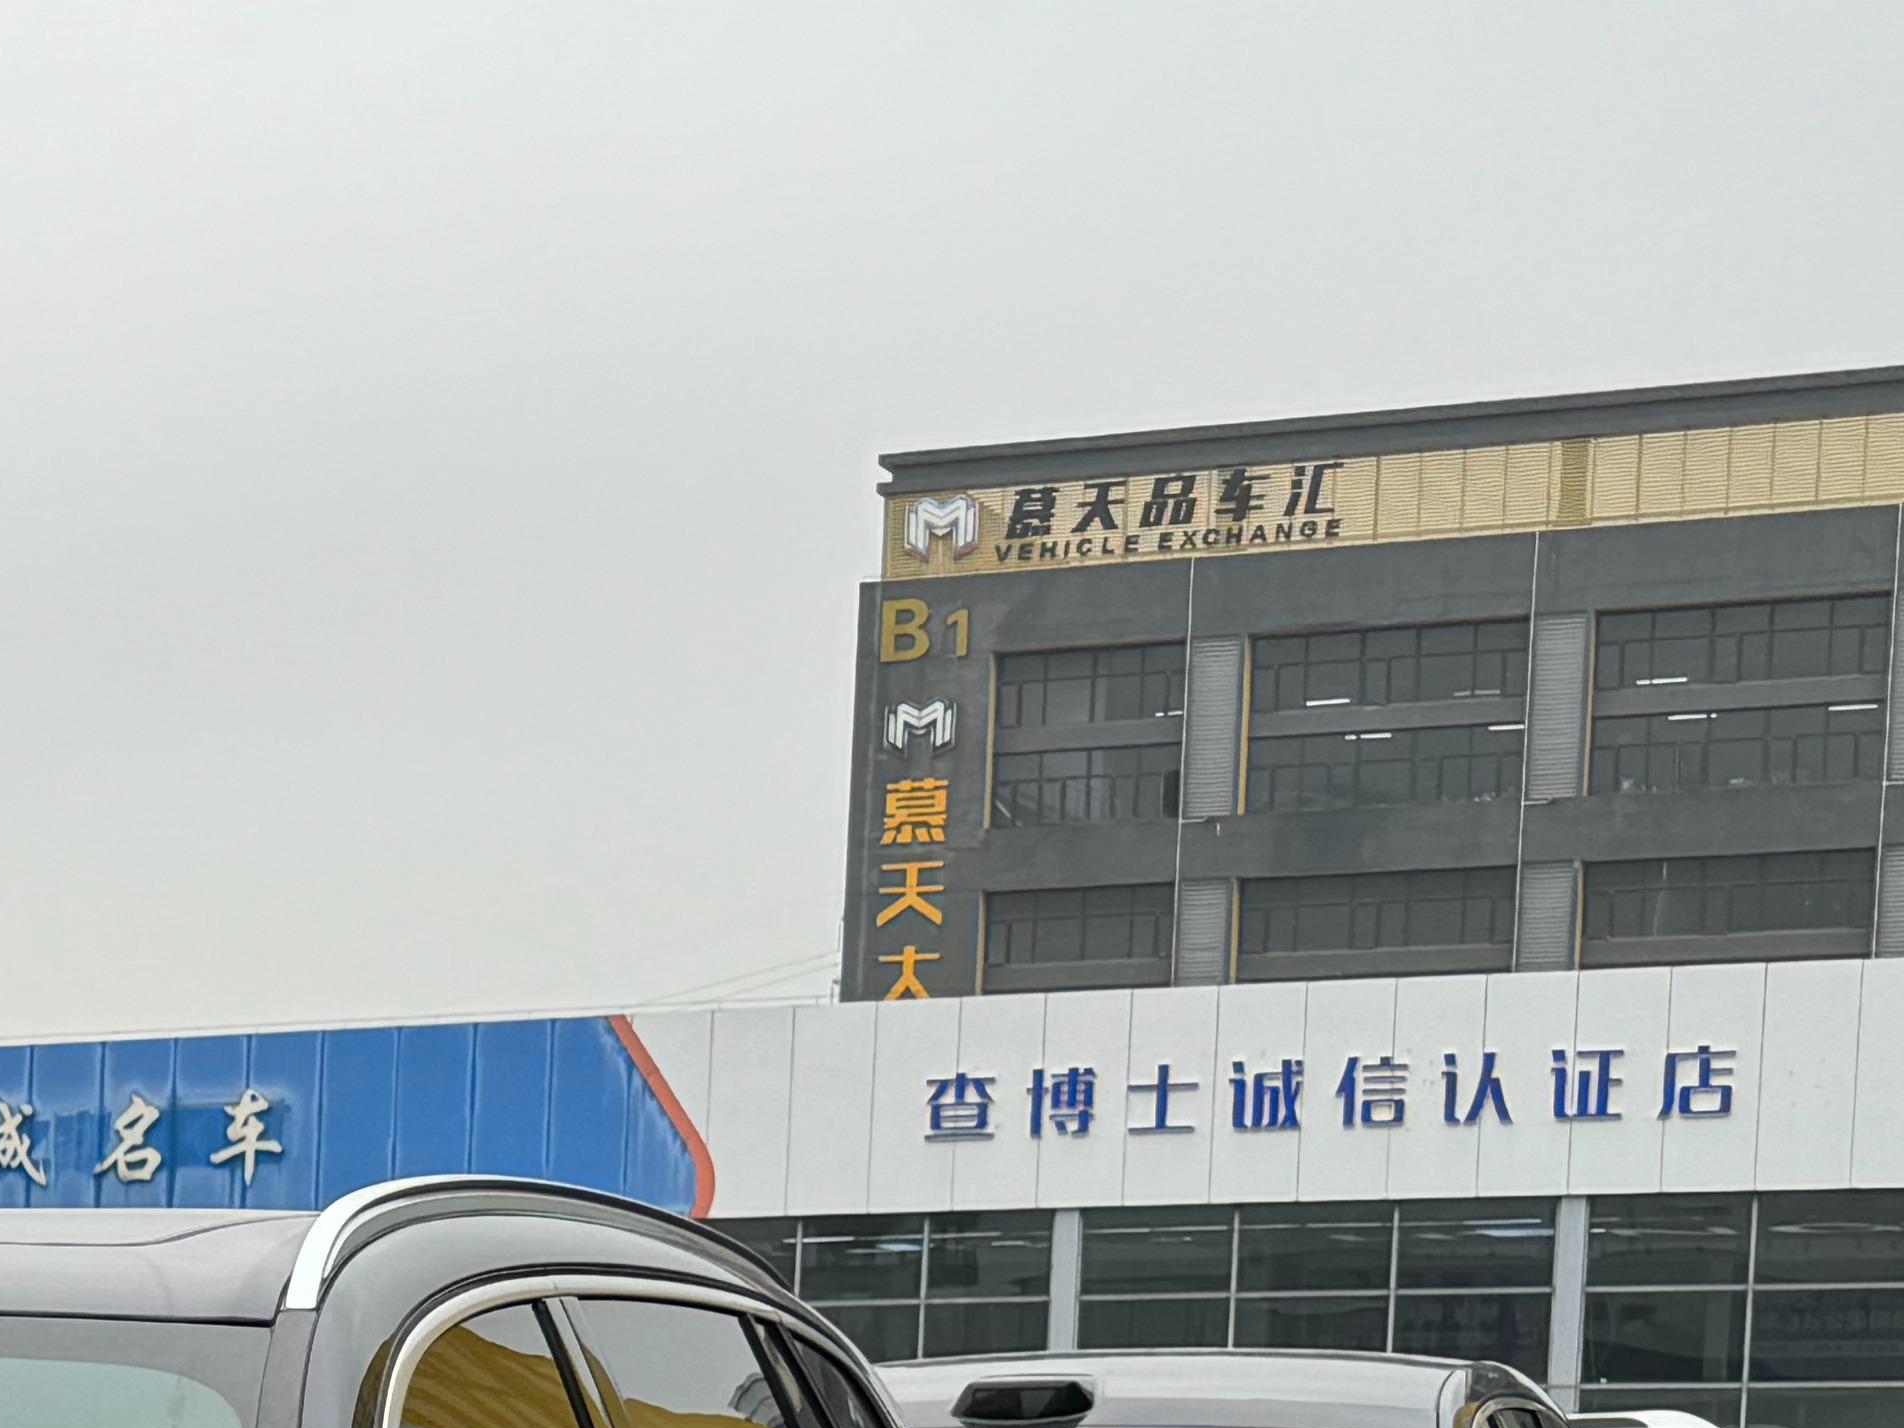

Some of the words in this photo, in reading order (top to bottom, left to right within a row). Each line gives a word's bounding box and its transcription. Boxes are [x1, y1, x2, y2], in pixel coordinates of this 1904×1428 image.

[1005, 462, 1345, 540] 慕天品车汇
[995, 534, 1140, 563] VEHICLE
[1157, 518, 1341, 552] EXCHANGE
[879, 597, 970, 663] B1
[923, 1045, 1737, 1143] 查博士诚信认证店
